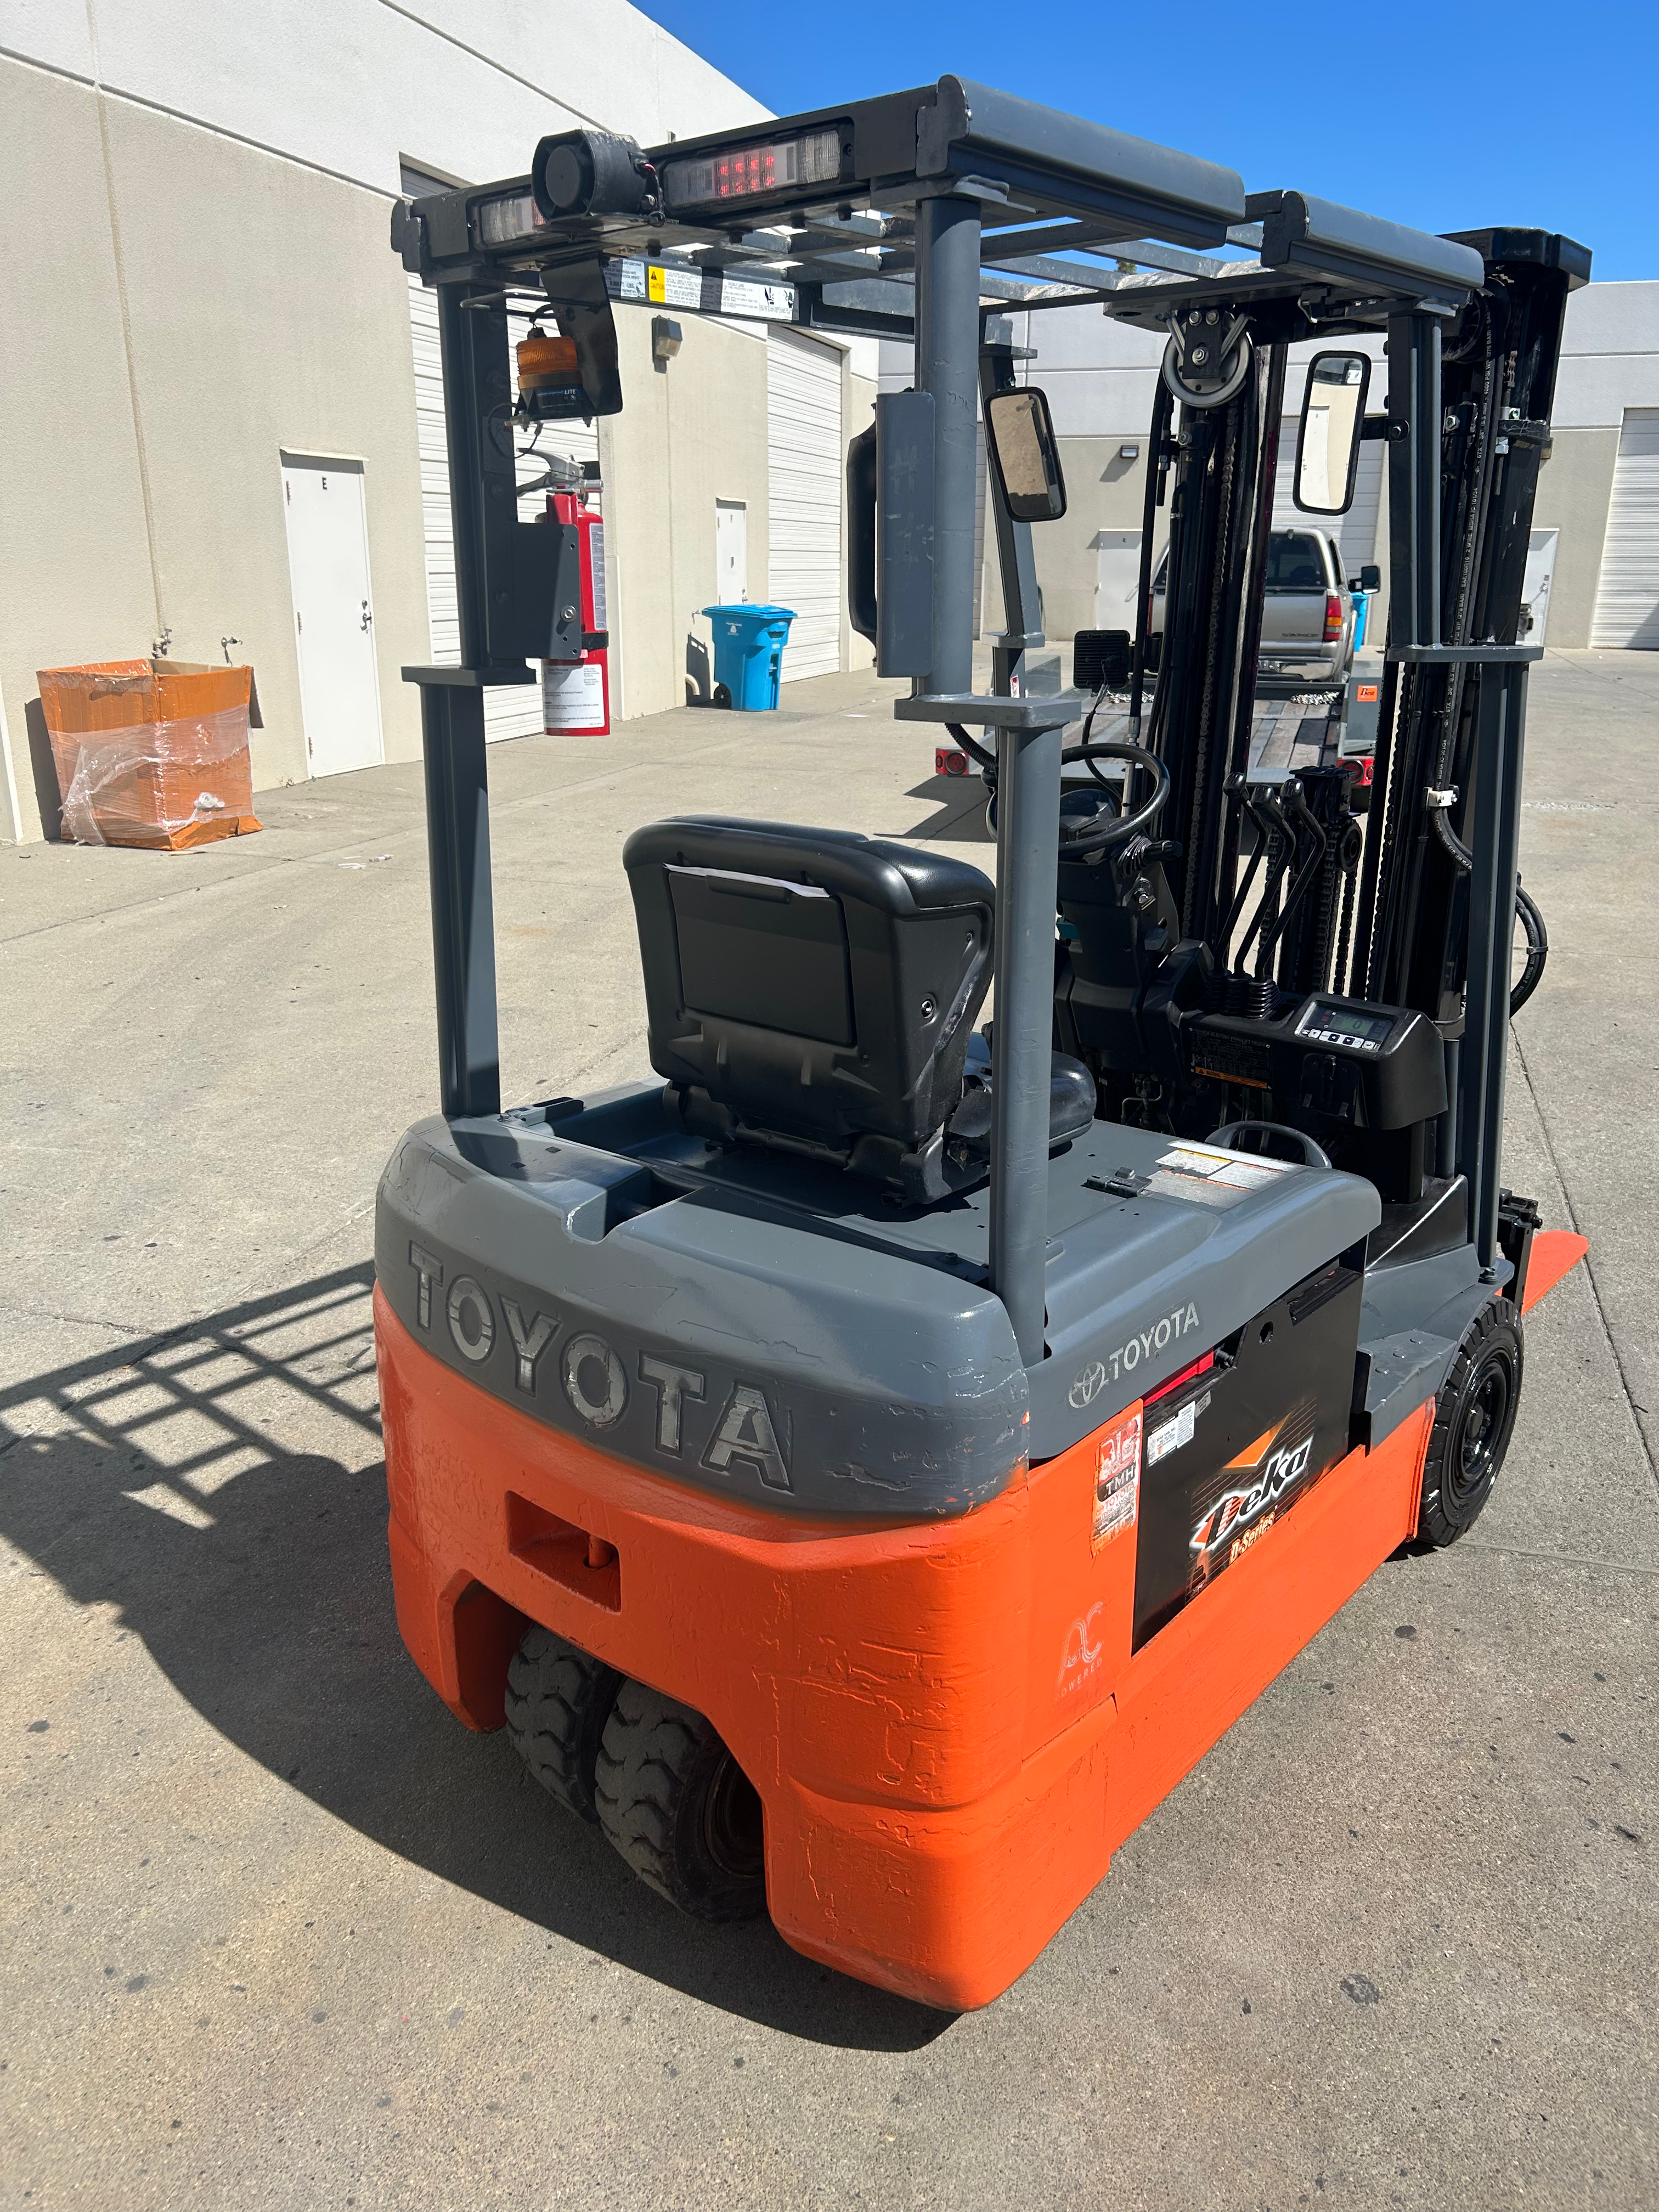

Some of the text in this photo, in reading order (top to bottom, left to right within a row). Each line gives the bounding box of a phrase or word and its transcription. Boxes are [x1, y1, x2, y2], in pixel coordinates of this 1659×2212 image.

[321, 477, 328, 490] E
[1525, 967, 1534, 981] WIRE
[409, 1240, 795, 1494] TOYOTA
[1109, 1302, 1199, 1380] TOYOTA
[1106, 1466, 1135, 1495] TMH
[1192, 1438, 1312, 1548] Deka
[1229, 1511, 1275, 1565] D-Series
